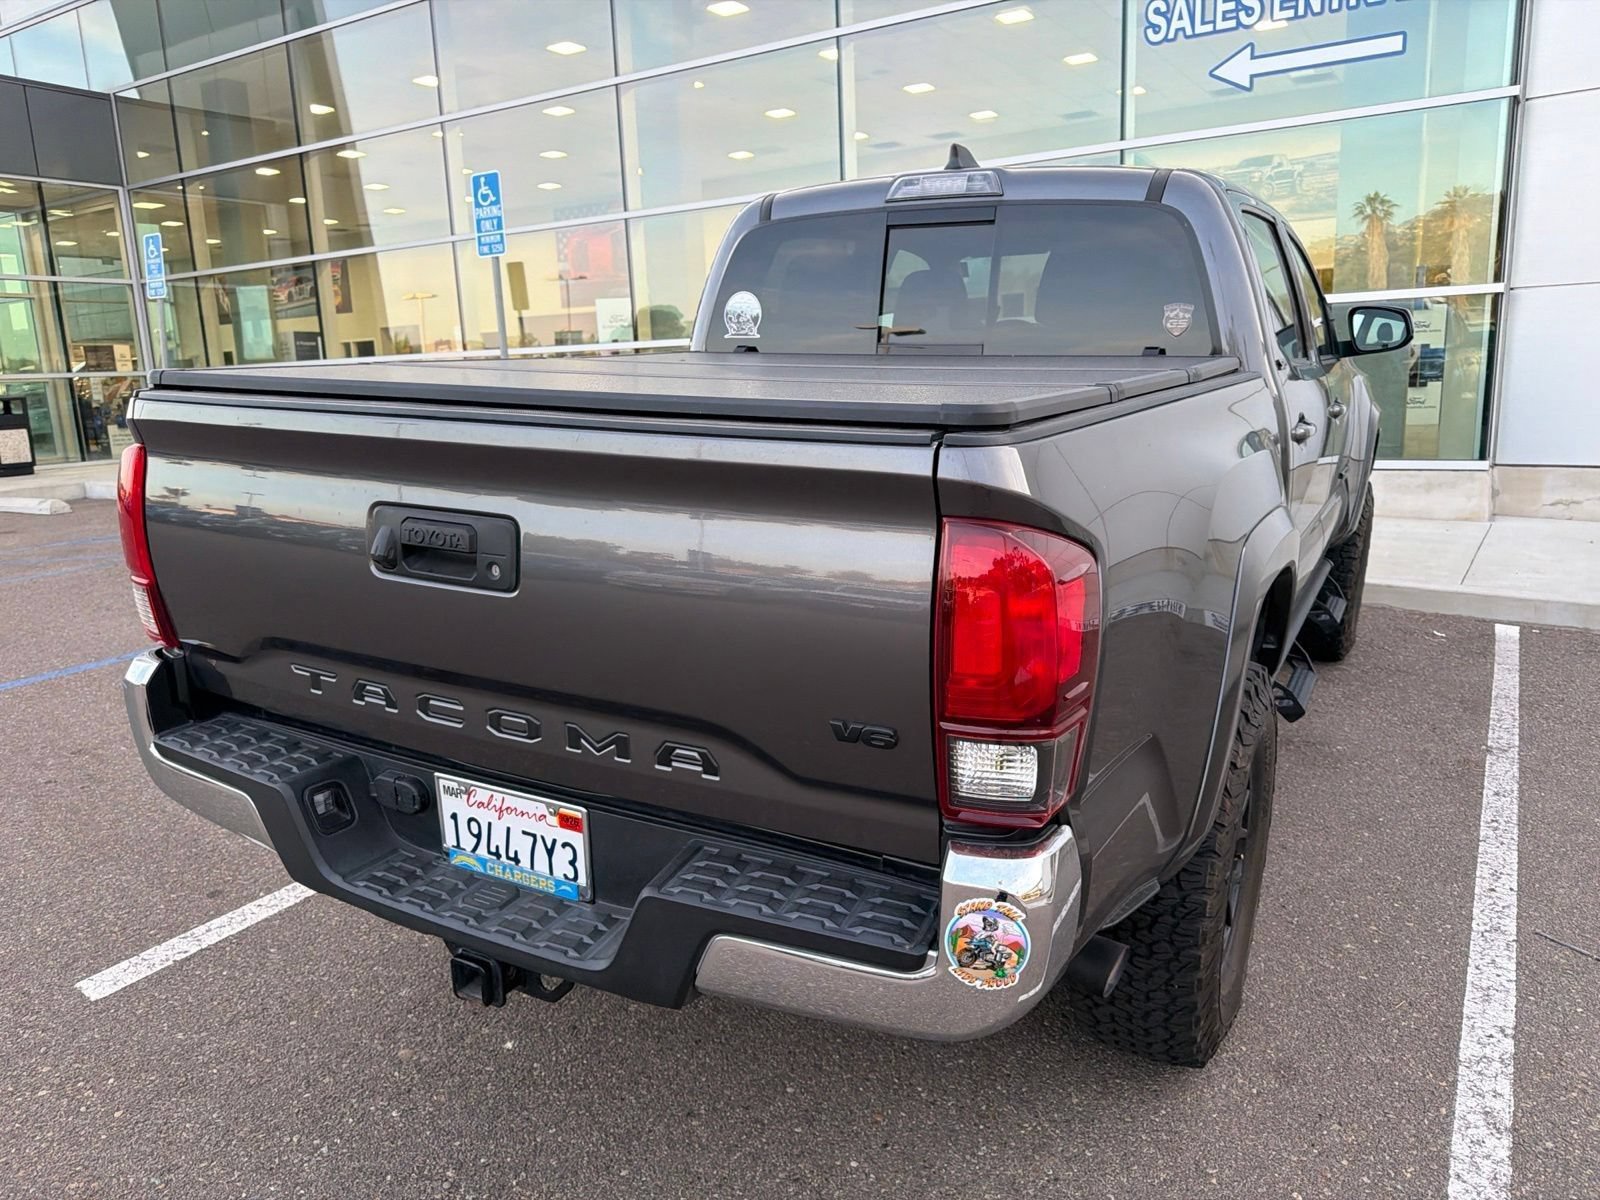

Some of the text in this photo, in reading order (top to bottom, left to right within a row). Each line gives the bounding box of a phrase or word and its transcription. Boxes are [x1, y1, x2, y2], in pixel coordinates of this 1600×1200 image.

[1145, 0, 1262, 45] SALES
[475, 205, 502, 219] PARKING
[480, 219, 498, 232] ONLY
[404, 527, 467, 550] TOYOTA
[291, 664, 720, 781] TACOMA
[829, 719, 899, 750] V6
[442, 784, 463, 799] MAR
[466, 788, 558, 828] California
[450, 812, 579, 883] 19447Y3
[486, 863, 556, 893] CHARGERS
